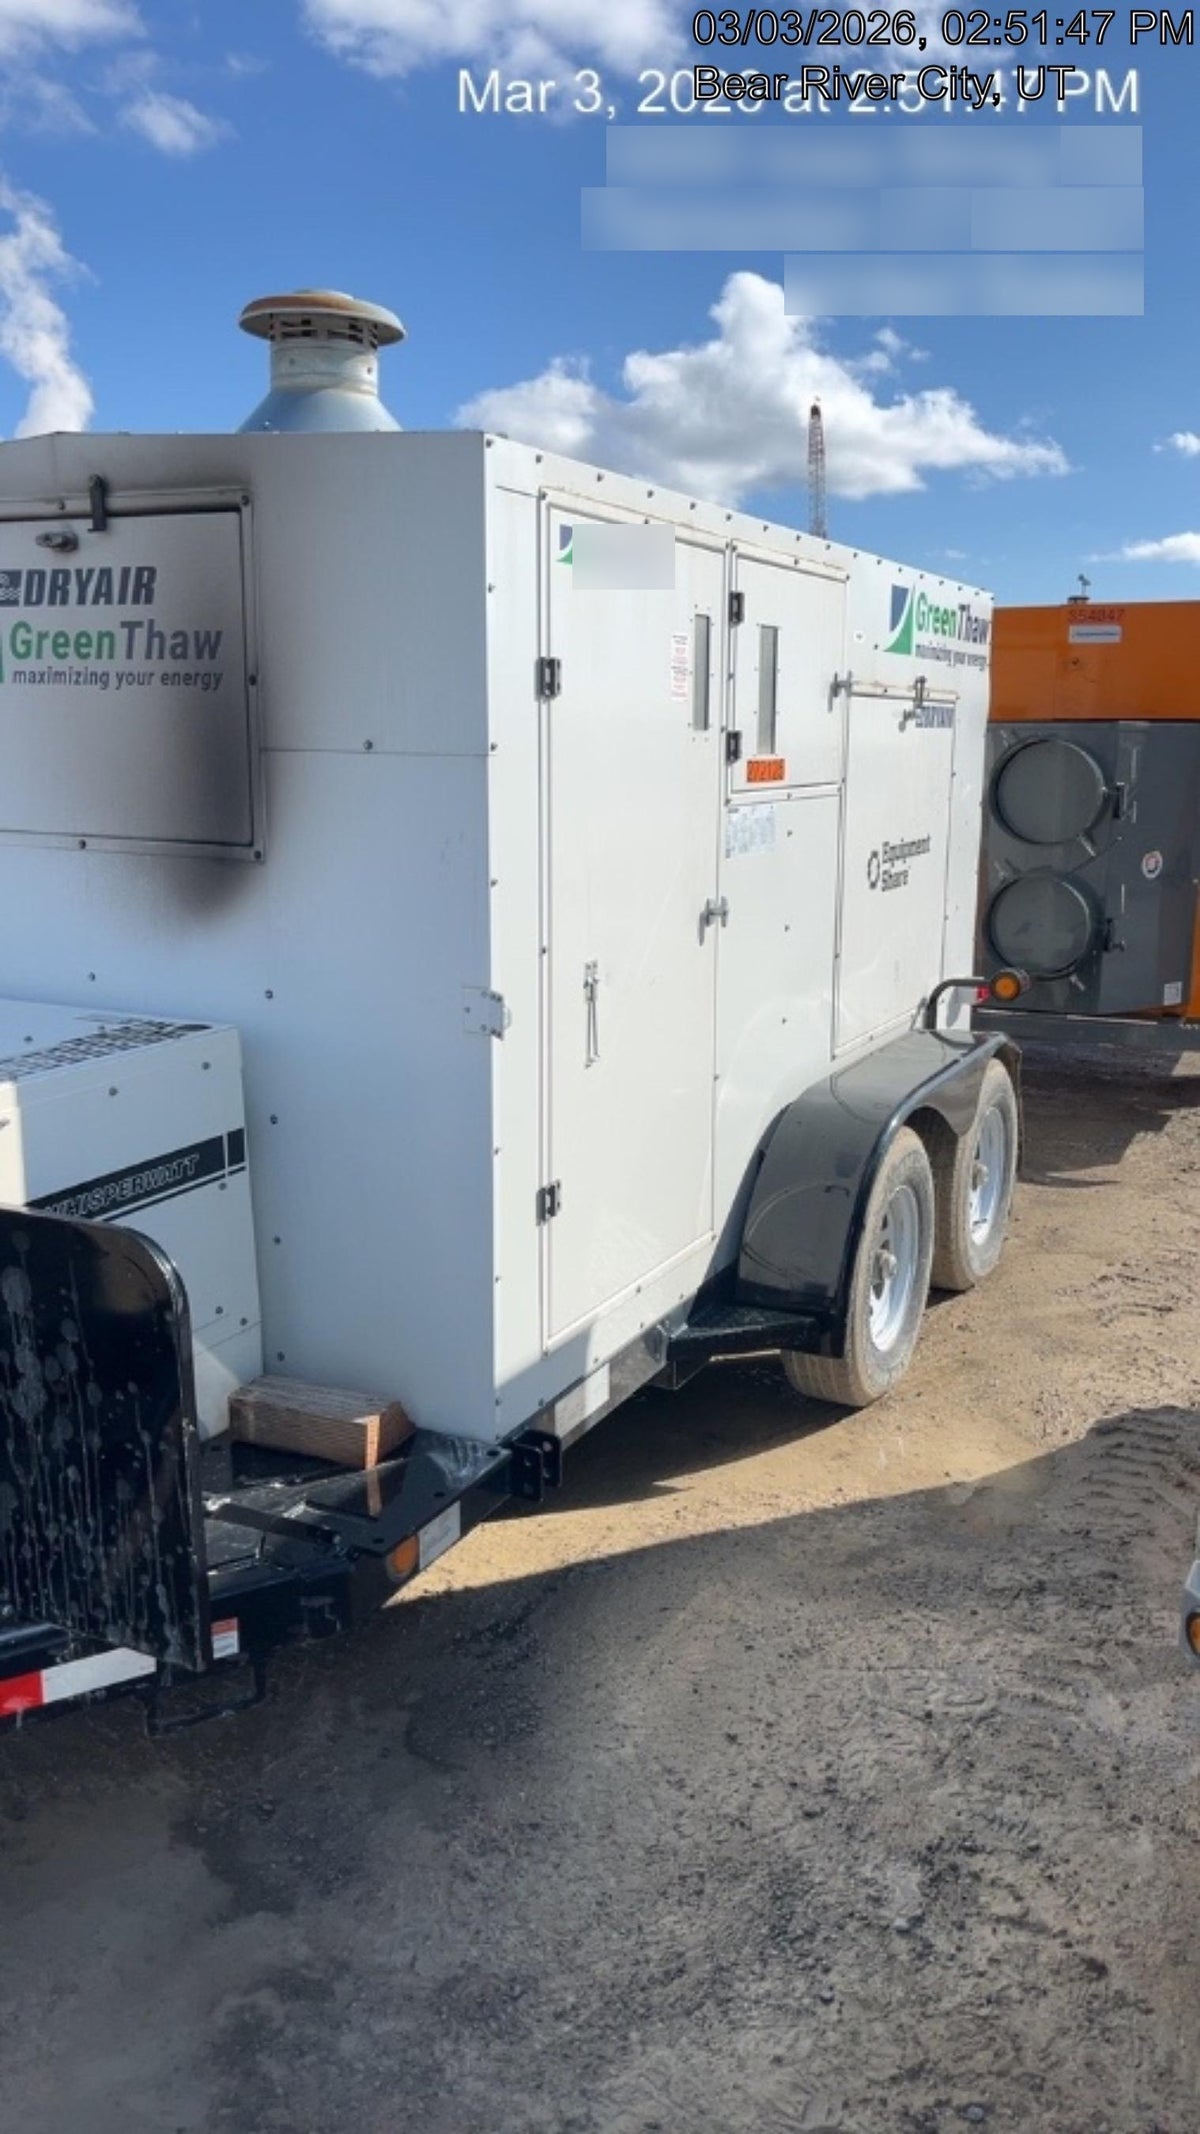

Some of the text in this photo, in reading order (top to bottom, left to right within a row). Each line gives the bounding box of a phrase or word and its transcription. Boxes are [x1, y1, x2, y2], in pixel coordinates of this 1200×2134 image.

[23, 566, 157, 607] DRYAIR
[915, 592, 988, 644] GreenThaw
[9, 618, 223, 660] GreenThaw
[12, 666, 224, 691] maximizing your energy
[881, 833, 931, 868] Equipment
[881, 866, 910, 891] Share
